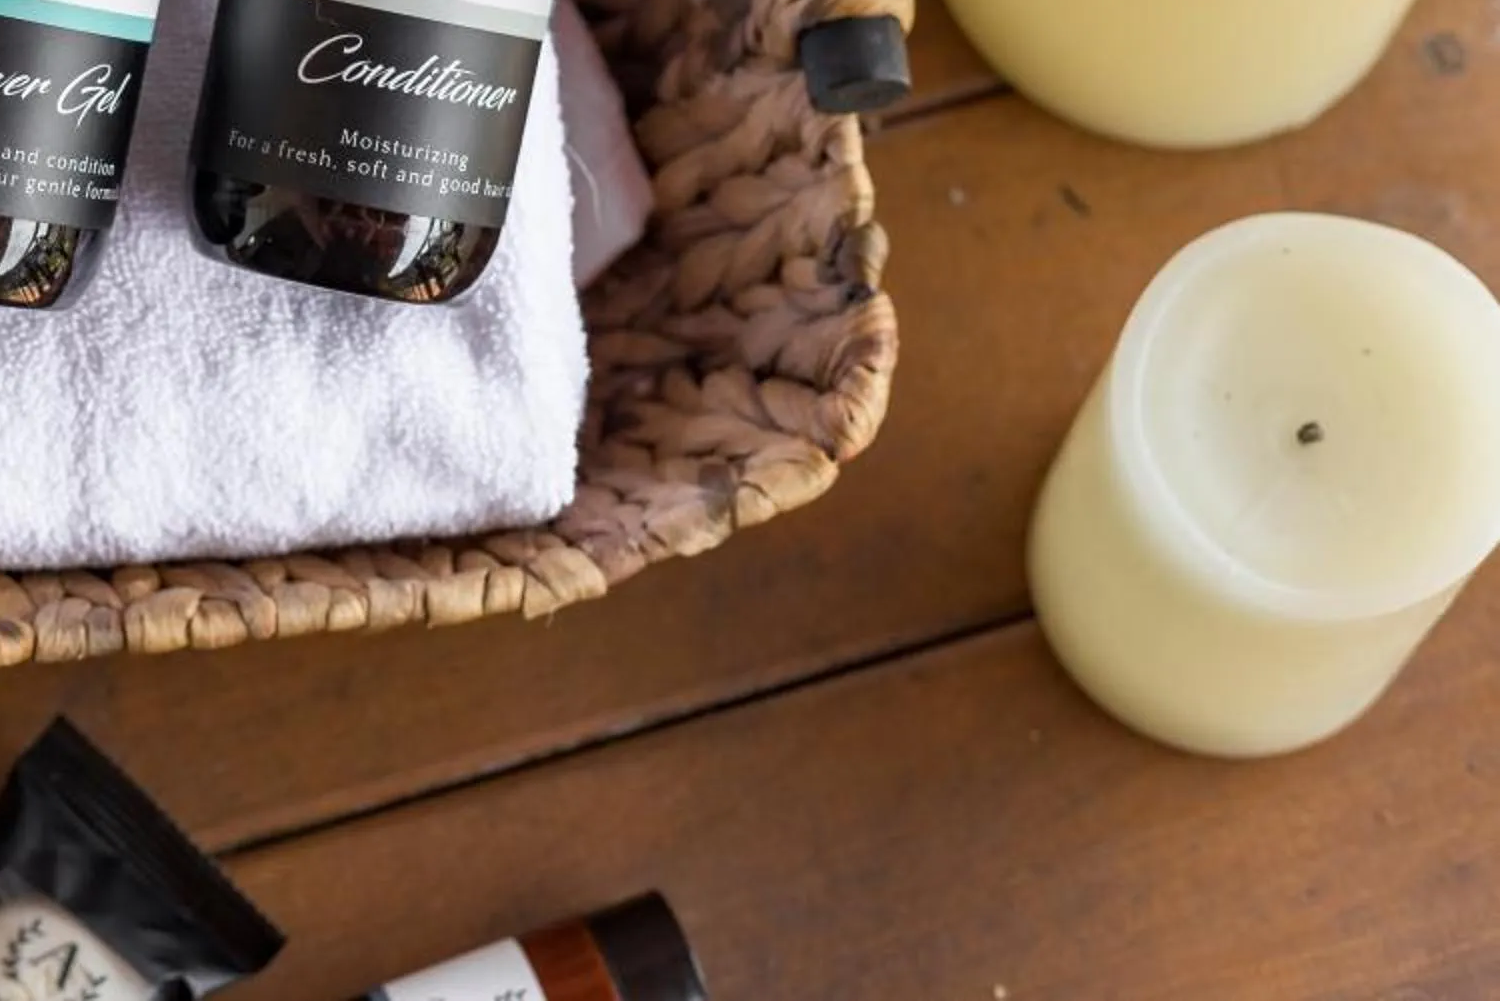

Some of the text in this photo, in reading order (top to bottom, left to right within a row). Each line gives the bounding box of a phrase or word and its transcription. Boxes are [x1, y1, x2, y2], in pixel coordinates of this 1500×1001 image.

[56, 63, 132, 127] Gel
[297, 33, 518, 113] Conditioner
[1, 146, 39, 165] and
[228, 129, 256, 152] For
[261, 139, 271, 154] a
[346, 156, 389, 180] soft
[396, 169, 434, 186] and
[440, 177, 481, 194] good
[339, 128, 470, 172] Moisturizing
[25, 177, 81, 198] gentle
